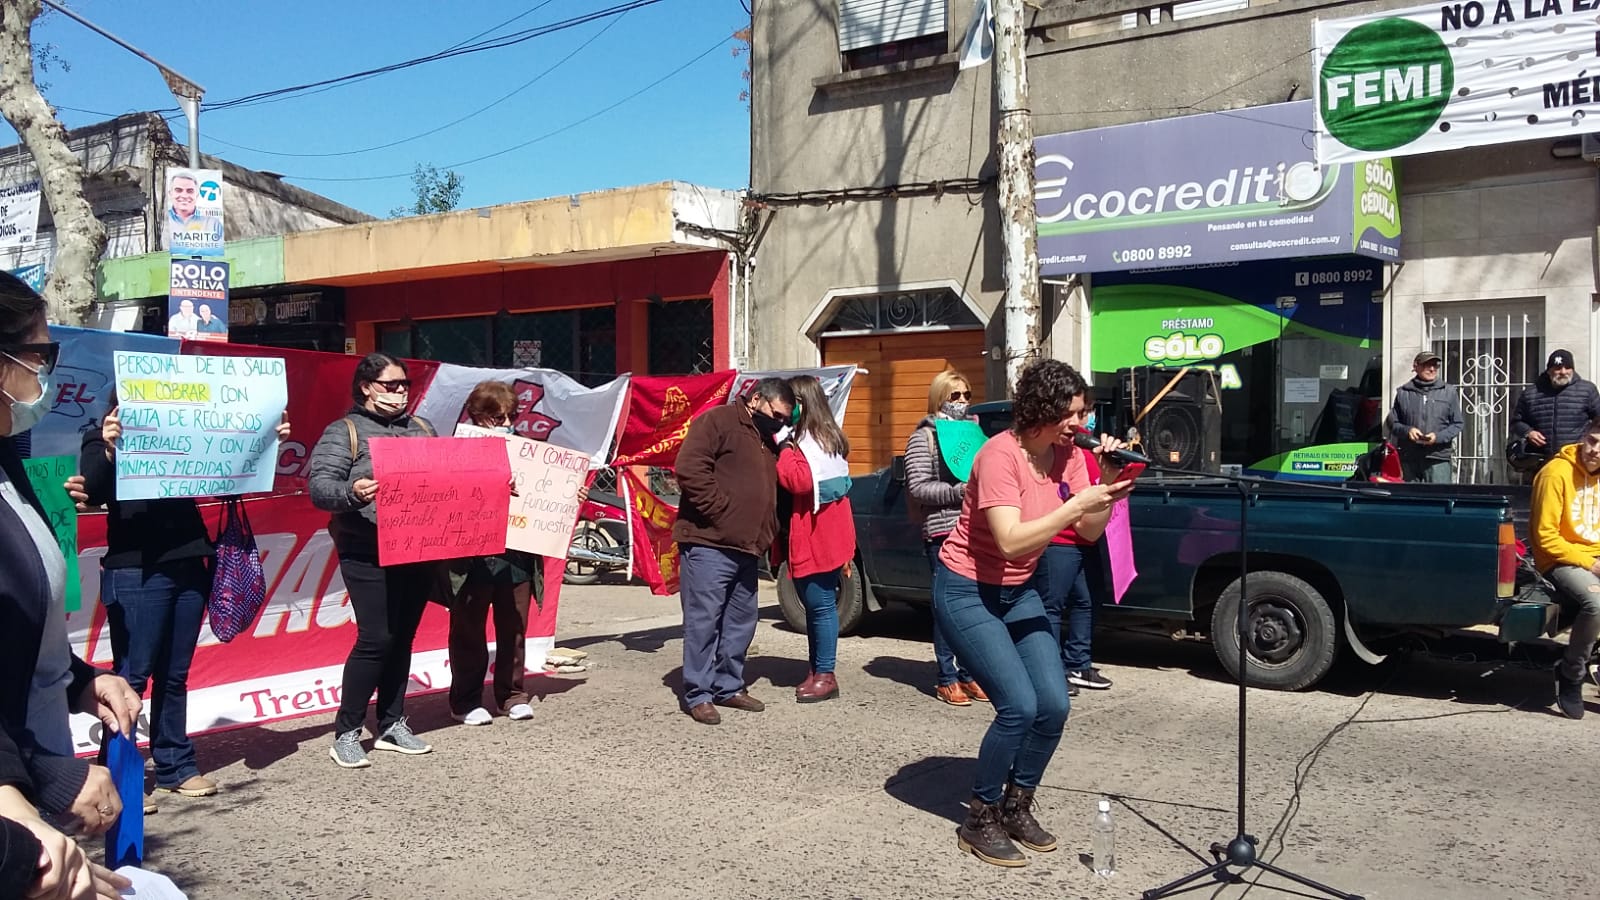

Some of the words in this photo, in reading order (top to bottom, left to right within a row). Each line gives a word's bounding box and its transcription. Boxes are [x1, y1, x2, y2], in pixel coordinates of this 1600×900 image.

[1441, 1, 1484, 31] NO
[1493, 0, 1515, 24] A
[1525, 0, 1562, 19] LA
[1325, 63, 1442, 110] FEMI
[1365, 158, 1393, 192] SÓLO
[1361, 186, 1395, 225] CÉDULA
[1207, 220, 1246, 232] Pensando
[1246, 219, 1257, 229] en
[1258, 219, 1268, 227] tu
[173, 231, 221, 242] MARITO
[1121, 249, 1154, 263] 0800
[1157, 245, 1192, 260] 8992
[171, 263, 226, 281] ROLO
[1311, 272, 1340, 284] 0800
[1343, 269, 1373, 283] 8992
[171, 279, 189, 288] DA
[192, 280, 224, 291] SILVA
[172, 289, 222, 298] INTENDENTE
[1162, 317, 1214, 330] PRÉSTAMO
[1145, 333, 1222, 359] SÓLO
[117, 355, 184, 375] PERSONAL
[195, 356, 215, 375] DE
[222, 356, 237, 376] LA
[243, 357, 284, 377] SALUD
[120, 379, 145, 402] SIN
[220, 385, 249, 404] CON
[121, 408, 160, 428] FALTA
[168, 409, 187, 427] DE
[194, 409, 263, 431] RECURSOS
[203, 436, 214, 454] Y
[220, 438, 244, 453] CON
[249, 436, 268, 454] LAS
[173, 459, 232, 476] MEDIDAS
[242, 457, 260, 474] DE
[519, 442, 537, 458] EN
[544, 447, 590, 472] CONFLICTO
[55, 458, 66, 477] lo
[158, 479, 236, 497] SEGURIDAD
[535, 467, 552, 493] de
[51, 507, 71, 529] DE
